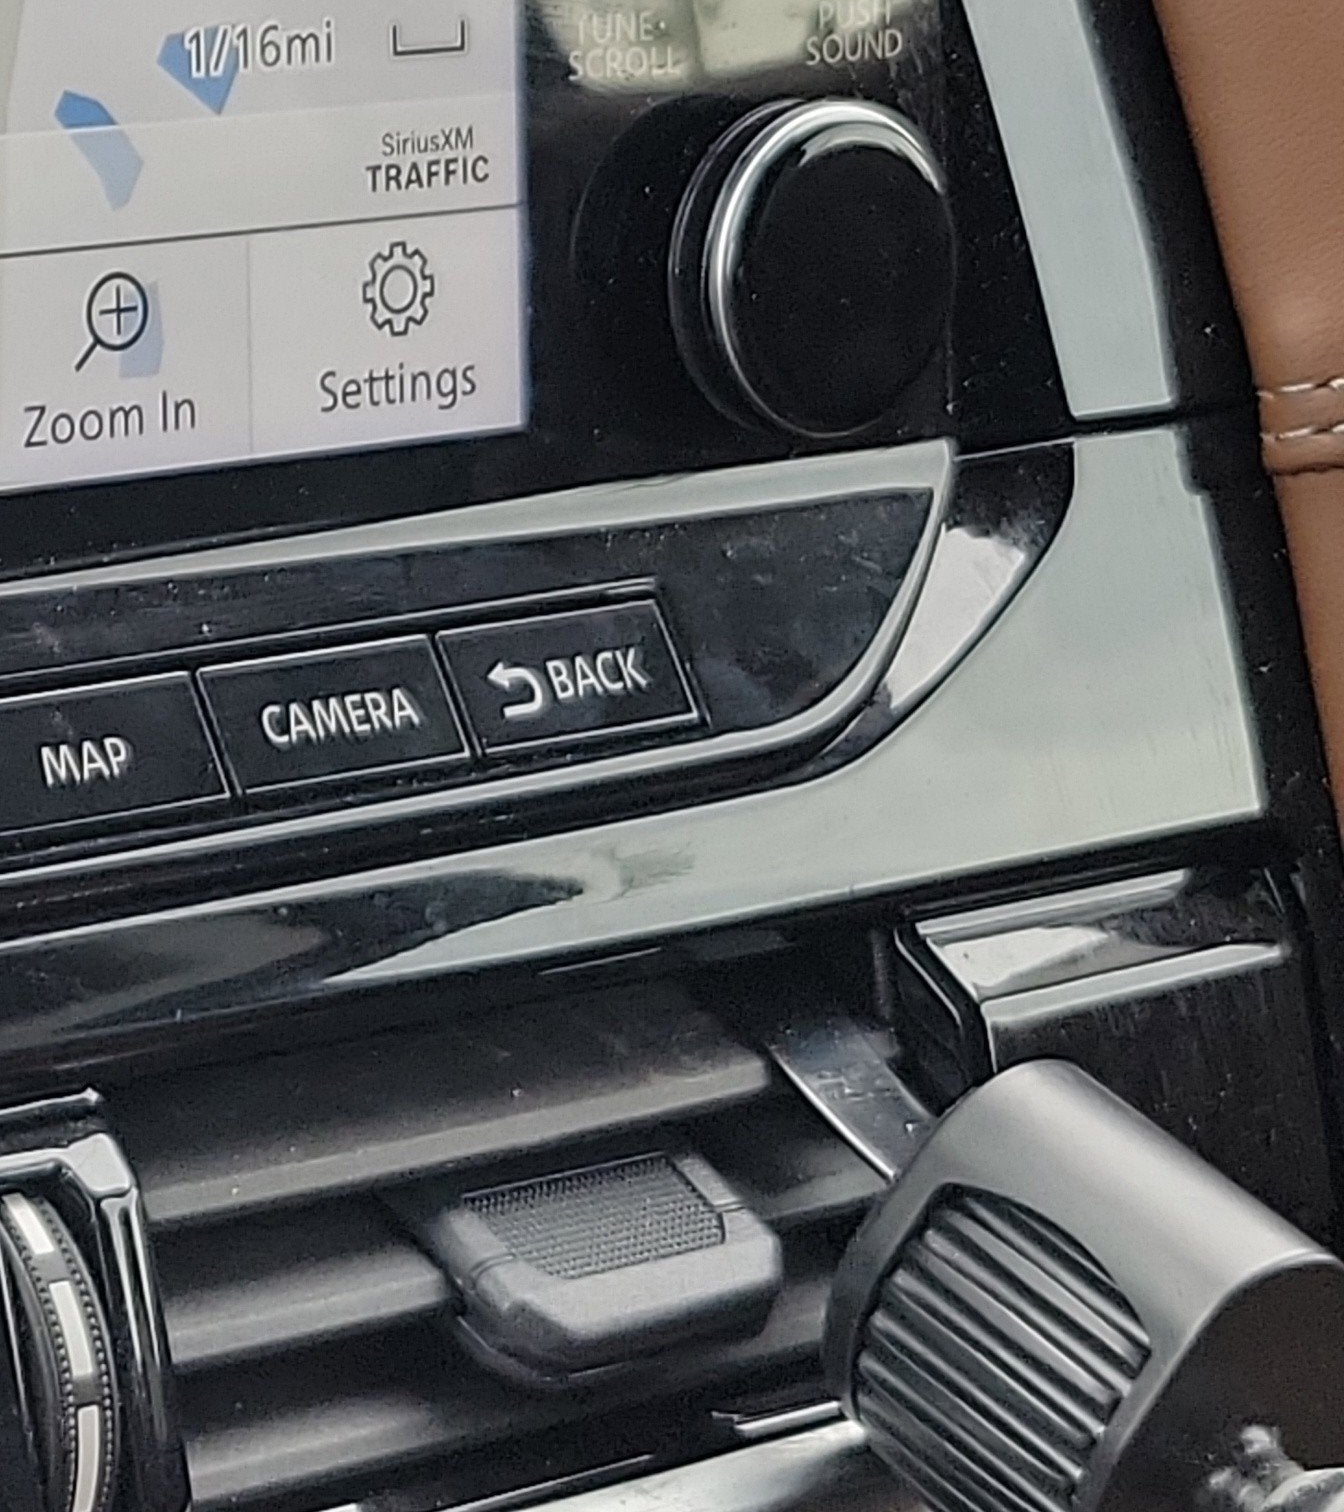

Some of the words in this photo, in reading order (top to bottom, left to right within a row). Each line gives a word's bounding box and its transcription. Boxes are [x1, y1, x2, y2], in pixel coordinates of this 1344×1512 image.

[183, 20, 335, 79] 1/16mi
[568, 46, 681, 81] SCROLL
[805, 28, 903, 66] SOUND
[381, 125, 475, 156] SiriusXM
[366, 155, 490, 194] TRAFFIC
[319, 361, 477, 414] Settings
[22, 405, 144, 449] Zoom
[160, 390, 196, 432] In
[547, 646, 648, 699] BACK
[260, 686, 420, 744] CAMERA
[40, 734, 132, 787] MAP
